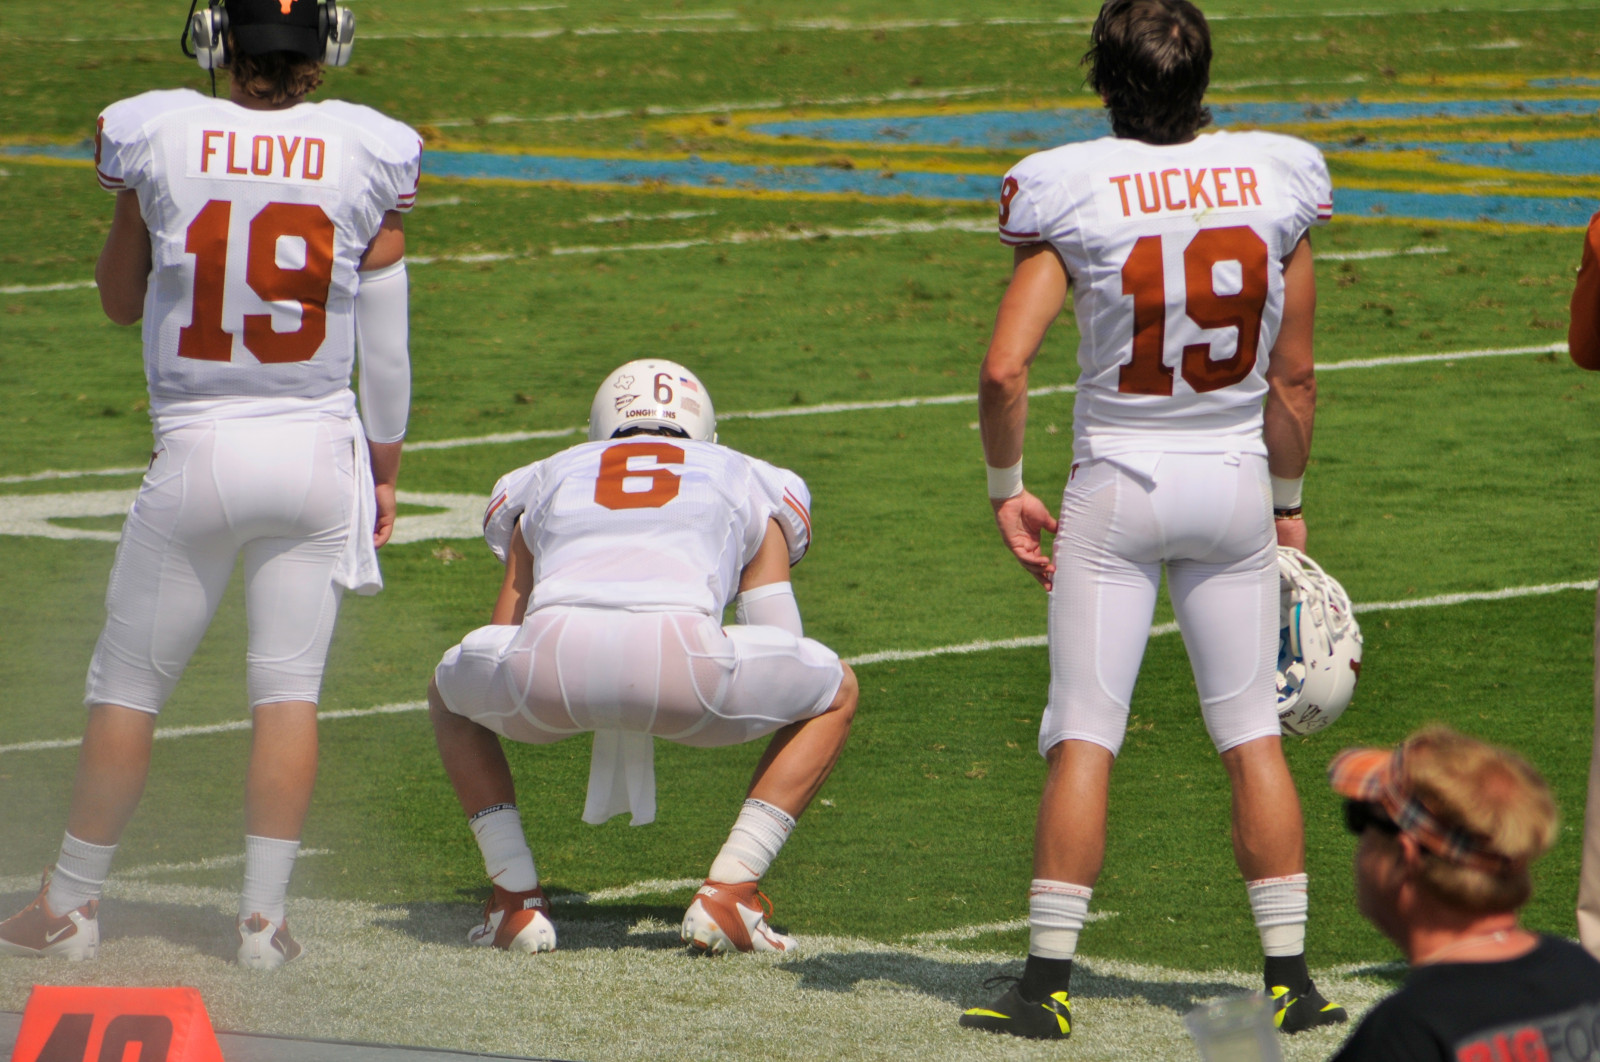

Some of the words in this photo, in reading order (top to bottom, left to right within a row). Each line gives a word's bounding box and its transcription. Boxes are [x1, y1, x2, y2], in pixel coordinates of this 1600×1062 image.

[202, 130, 325, 180] FLOYD
[1110, 167, 1263, 217] TUCKER
[179, 199, 335, 364] 19
[1119, 225, 1272, 396] 19
[654, 372, 674, 405] 6
[594, 442, 685, 510] 6
[523, 897, 543, 911] NIKE
